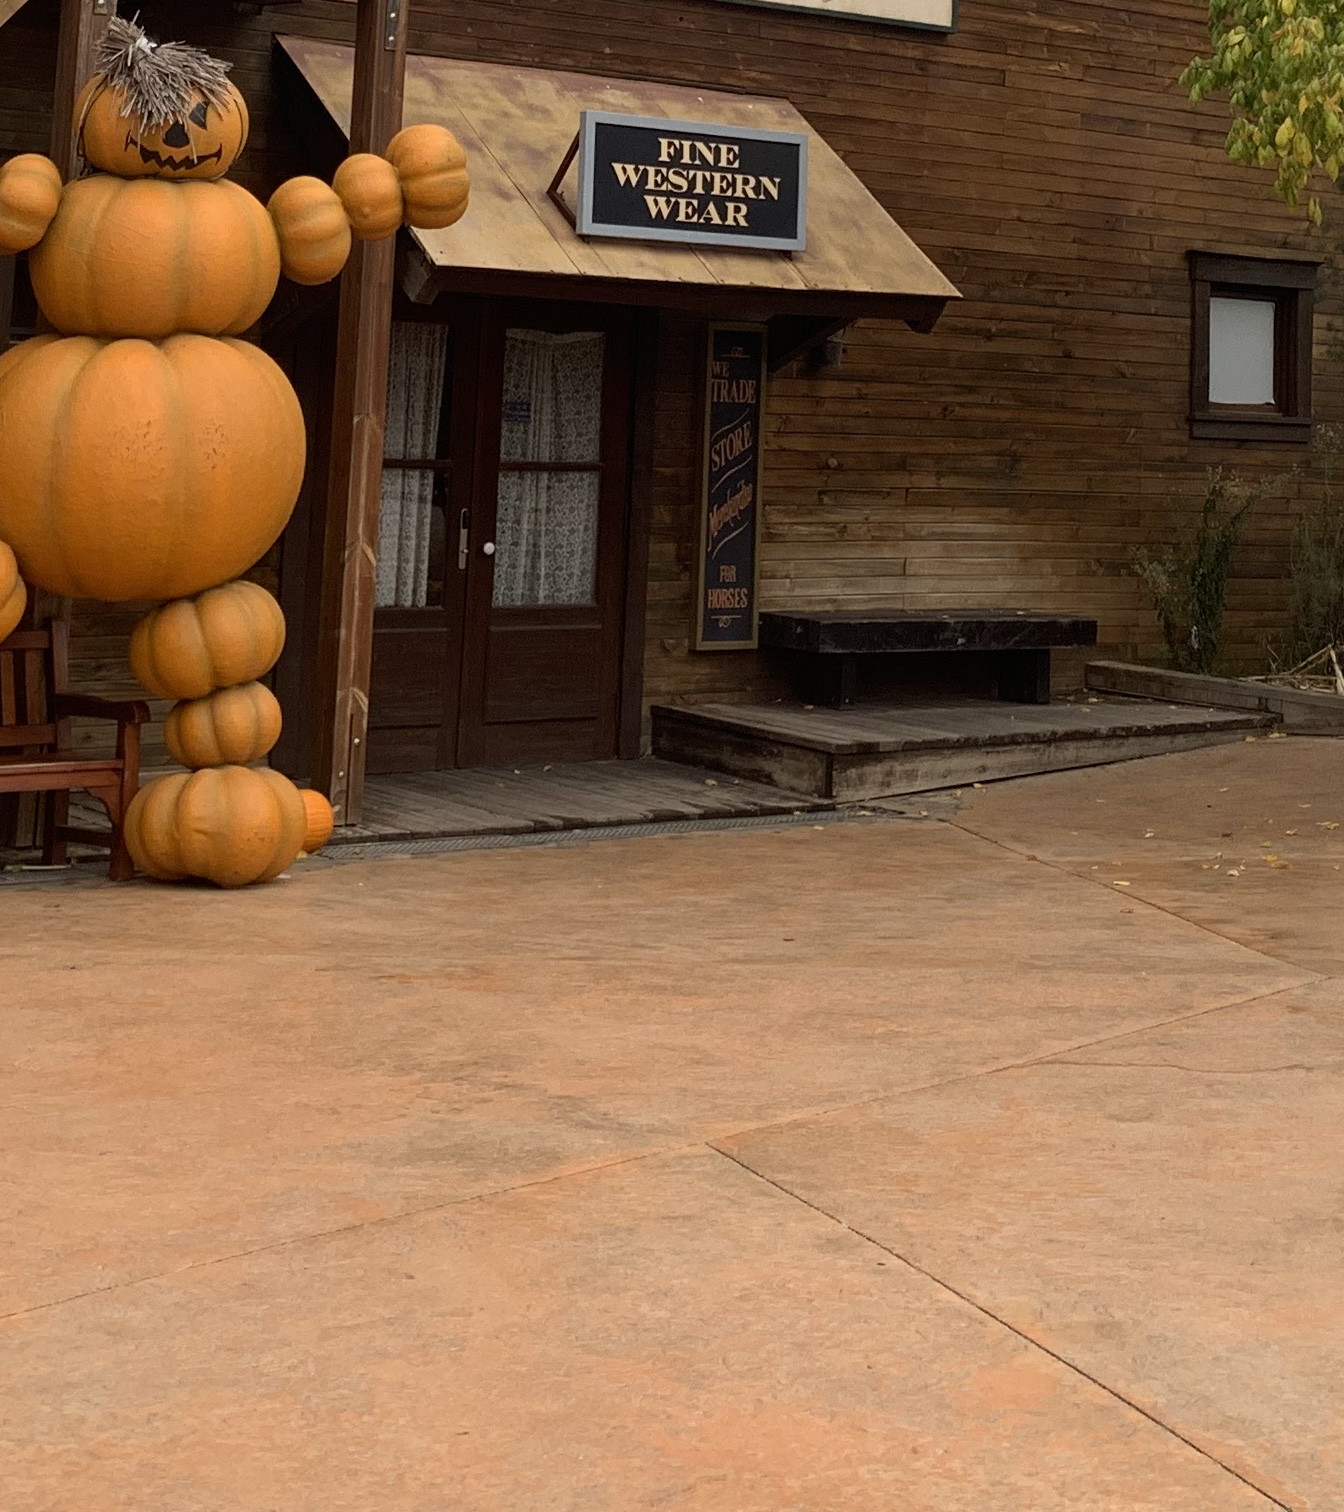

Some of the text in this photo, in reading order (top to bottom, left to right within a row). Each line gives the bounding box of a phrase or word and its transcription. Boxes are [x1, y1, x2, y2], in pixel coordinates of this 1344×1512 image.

[658, 137, 739, 168] FINE
[611, 162, 781, 201] WESTERN
[644, 194, 749, 227] WEAR
[711, 361, 730, 379] WE
[712, 378, 756, 404] TRADE
[711, 421, 752, 472] STORE
[719, 565, 736, 583] FOR
[707, 587, 748, 609] HORSES
